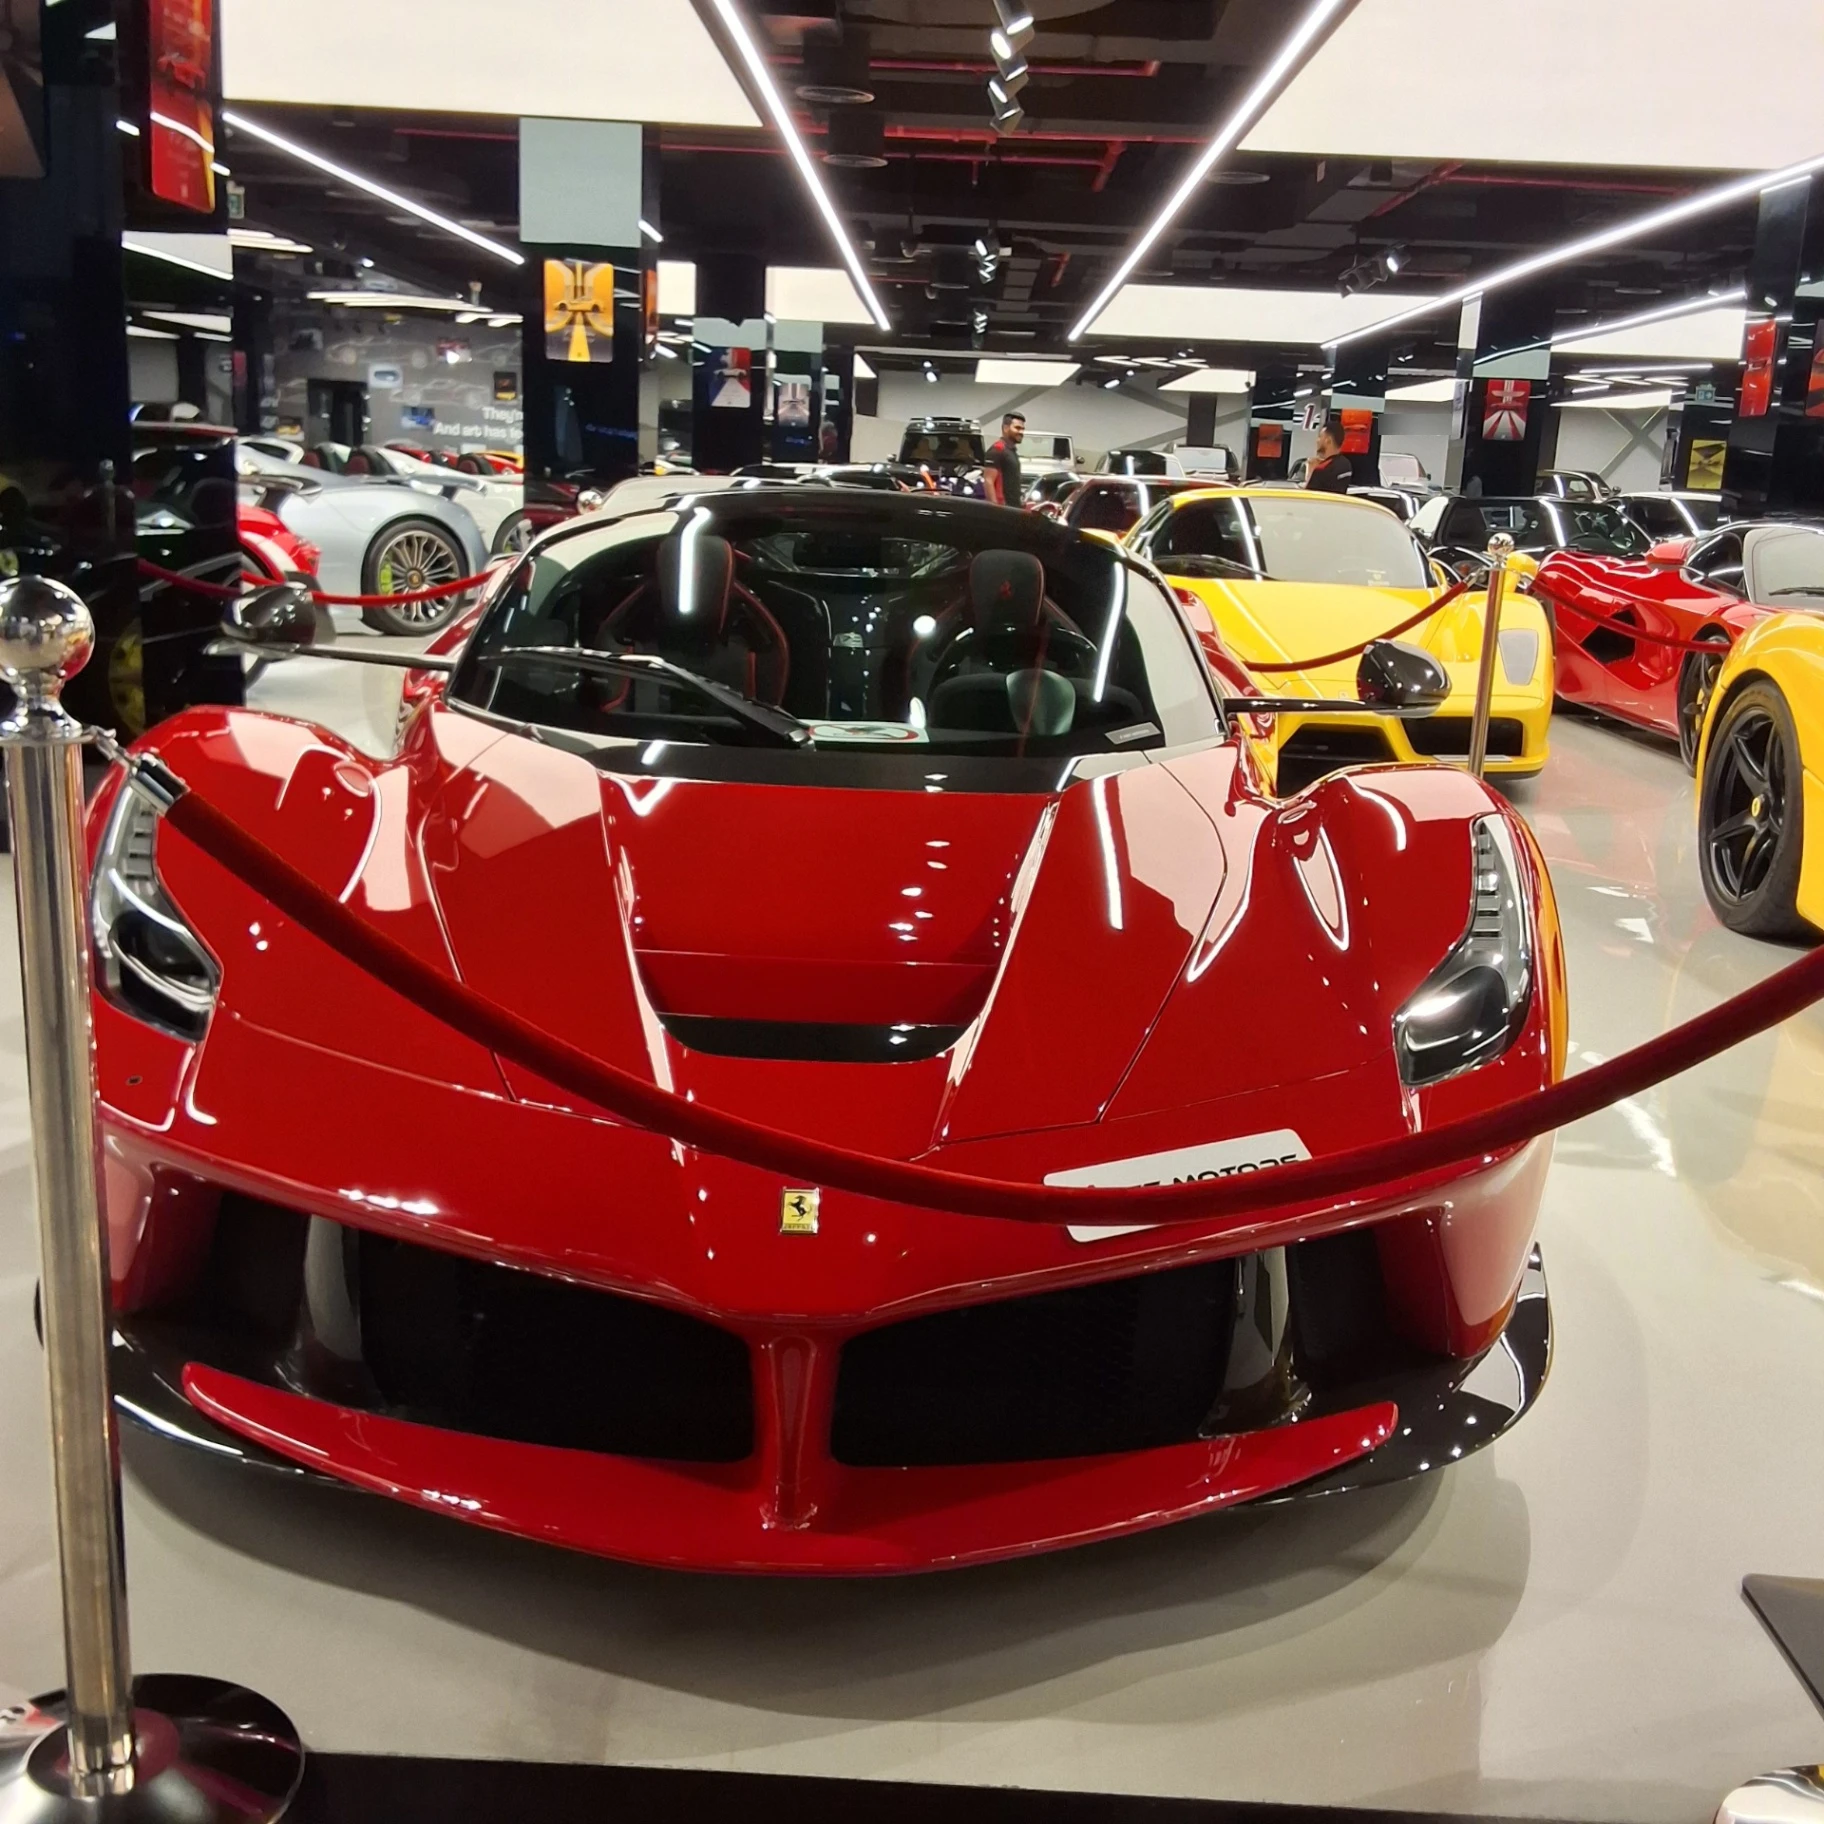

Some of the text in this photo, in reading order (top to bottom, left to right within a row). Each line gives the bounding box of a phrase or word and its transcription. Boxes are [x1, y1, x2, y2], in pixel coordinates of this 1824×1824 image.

[433, 422, 460, 436] And
[462, 425, 482, 437] art
[484, 425, 507, 438] has
